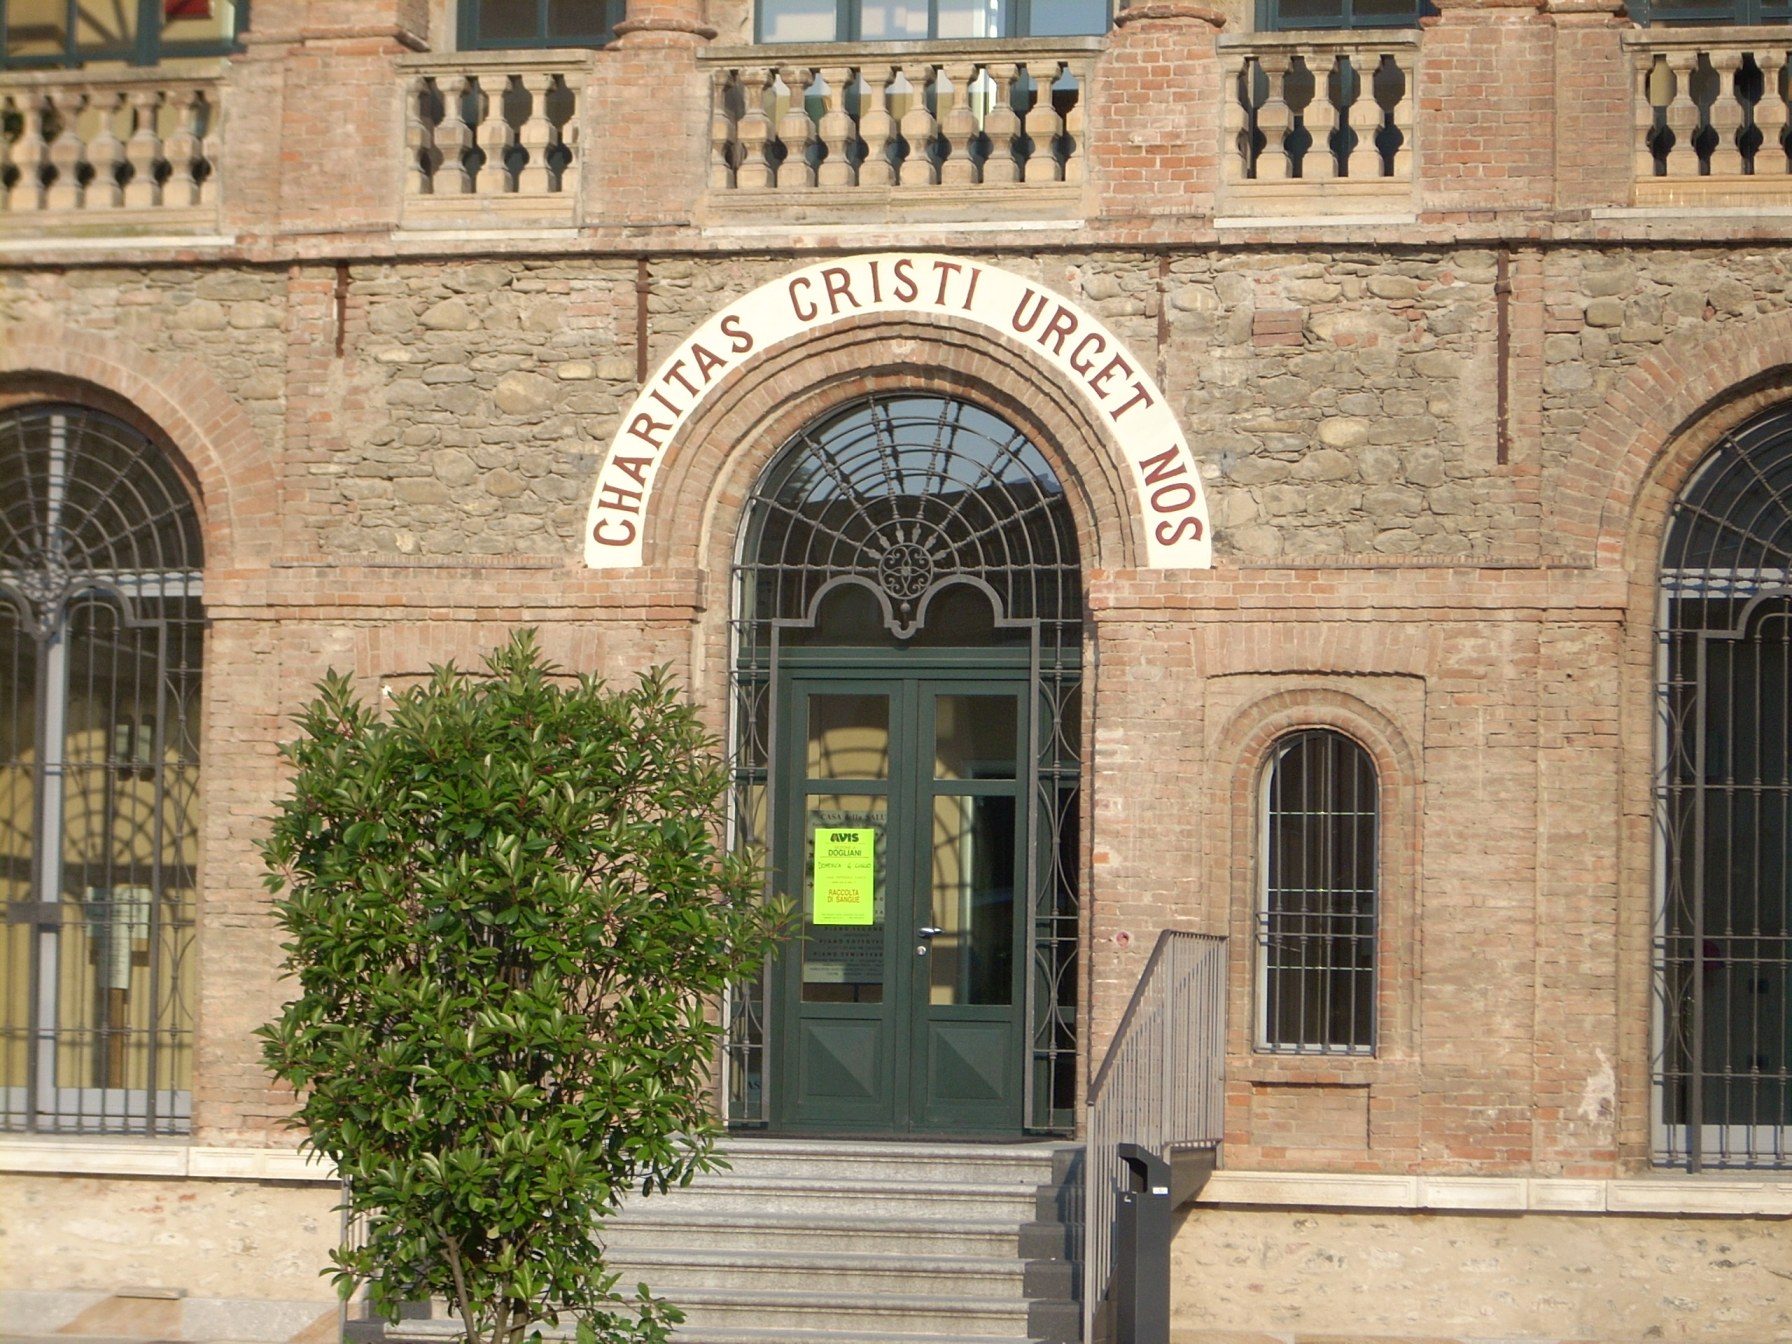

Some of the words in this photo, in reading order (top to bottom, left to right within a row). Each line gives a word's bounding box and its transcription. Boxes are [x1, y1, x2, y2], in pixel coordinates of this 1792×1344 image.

[593, 314, 754, 547] CHARITAS
[789, 258, 982, 322] CRISTI
[1013, 288, 1154, 422] URGET
[1139, 444, 1204, 547] NOS
[830, 833, 859, 842] AVIS
[829, 888, 859, 896] RACCOLTA
